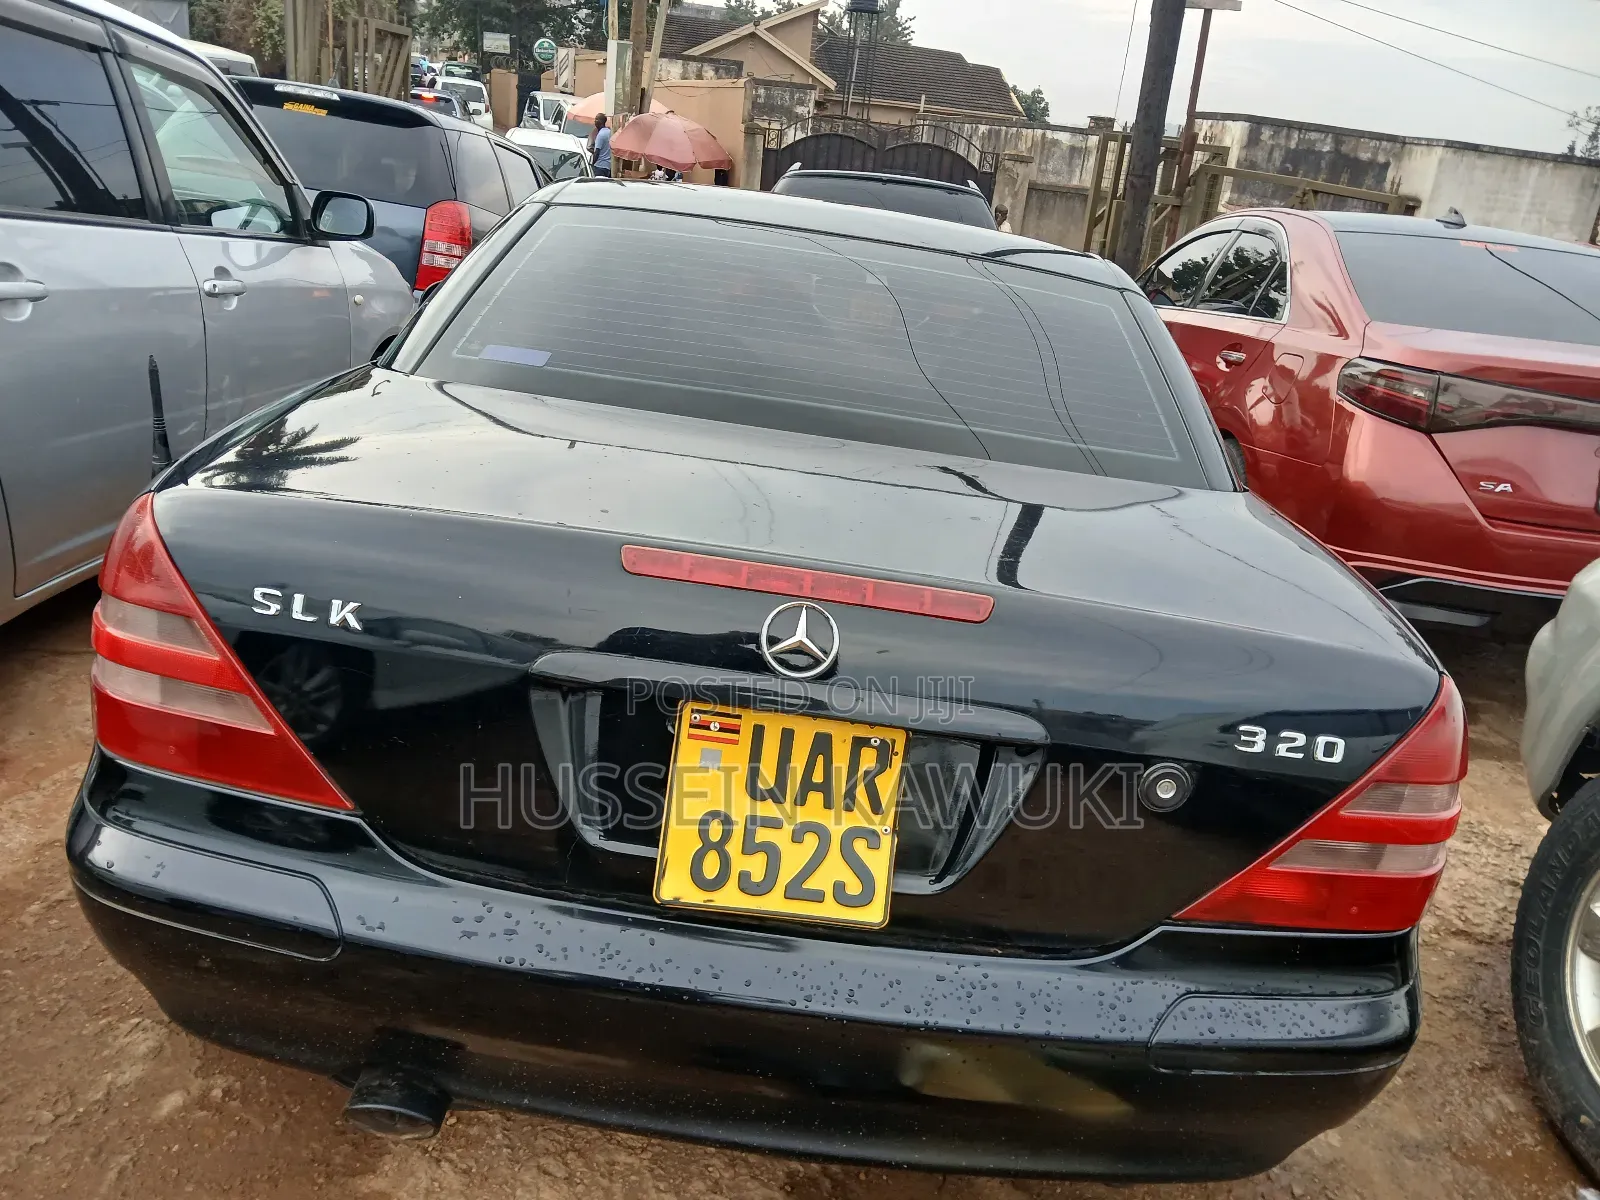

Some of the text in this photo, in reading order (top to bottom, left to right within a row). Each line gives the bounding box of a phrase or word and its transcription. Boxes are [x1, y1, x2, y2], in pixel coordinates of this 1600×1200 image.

[1479, 481, 1513, 493] SA
[251, 587, 363, 632] SLK
[1234, 725, 1346, 763] 320
[745, 723, 892, 815] UAR
[690, 809, 881, 908] 852S
